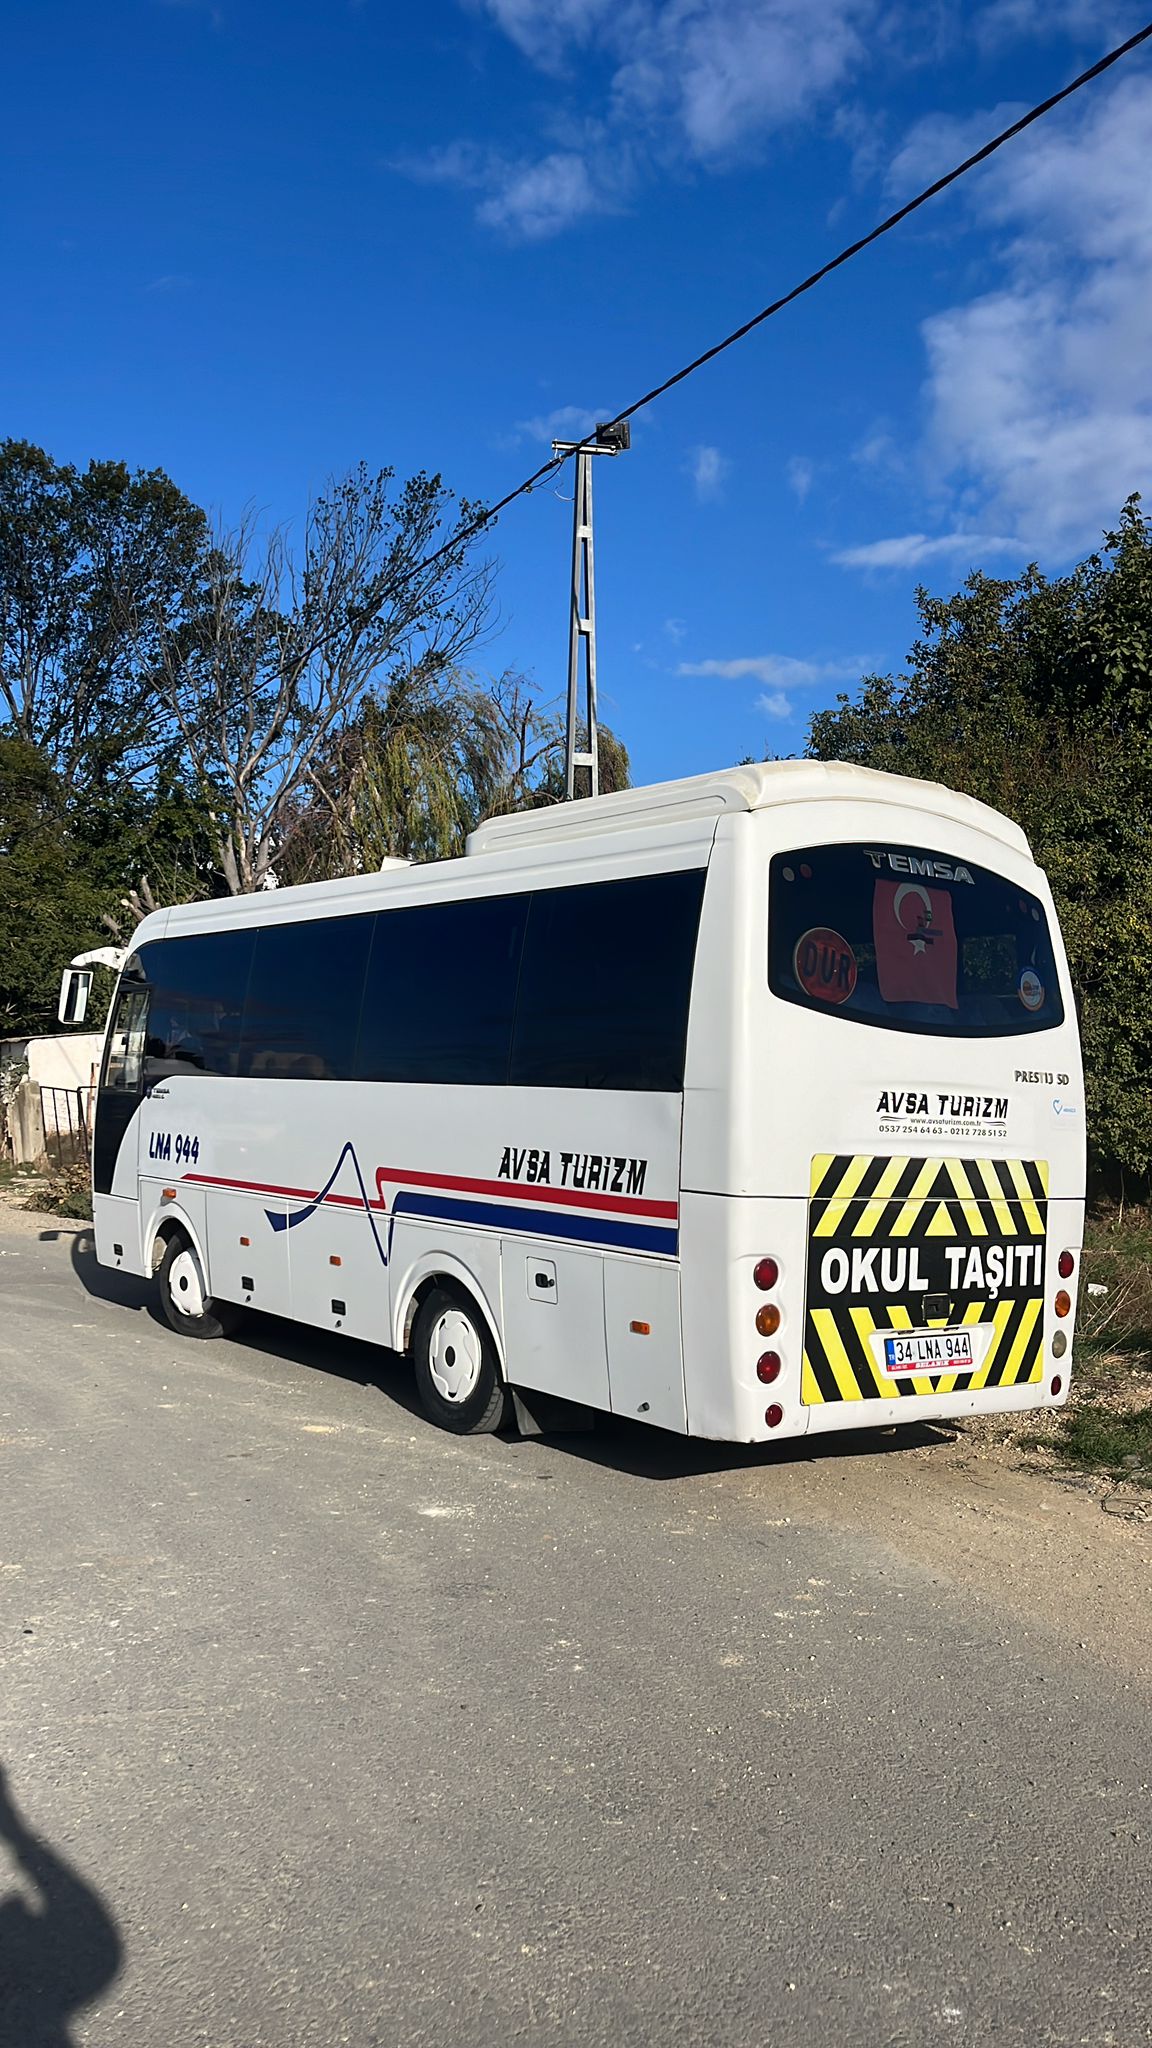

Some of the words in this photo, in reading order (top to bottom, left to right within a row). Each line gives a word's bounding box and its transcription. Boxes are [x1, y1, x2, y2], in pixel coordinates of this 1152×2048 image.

[863, 850, 975, 885] TEMSA
[802, 941, 851, 993] DUR
[1057, 1074, 1069, 1085] SD
[876, 1091, 929, 1115] AVSA
[879, 1125, 901, 1133] 0537
[920, 1126, 930, 1134] 64
[149, 1132, 171, 1161] LNA
[175, 1133, 200, 1165] 944
[498, 1146, 551, 1184] AVSA
[820, 1247, 929, 1295] OKUL
[945, 1244, 1043, 1299] TAŞITI
[896, 1341, 912, 1361] 34
[917, 1339, 942, 1360] LNA
[946, 1337, 968, 1358] 944
